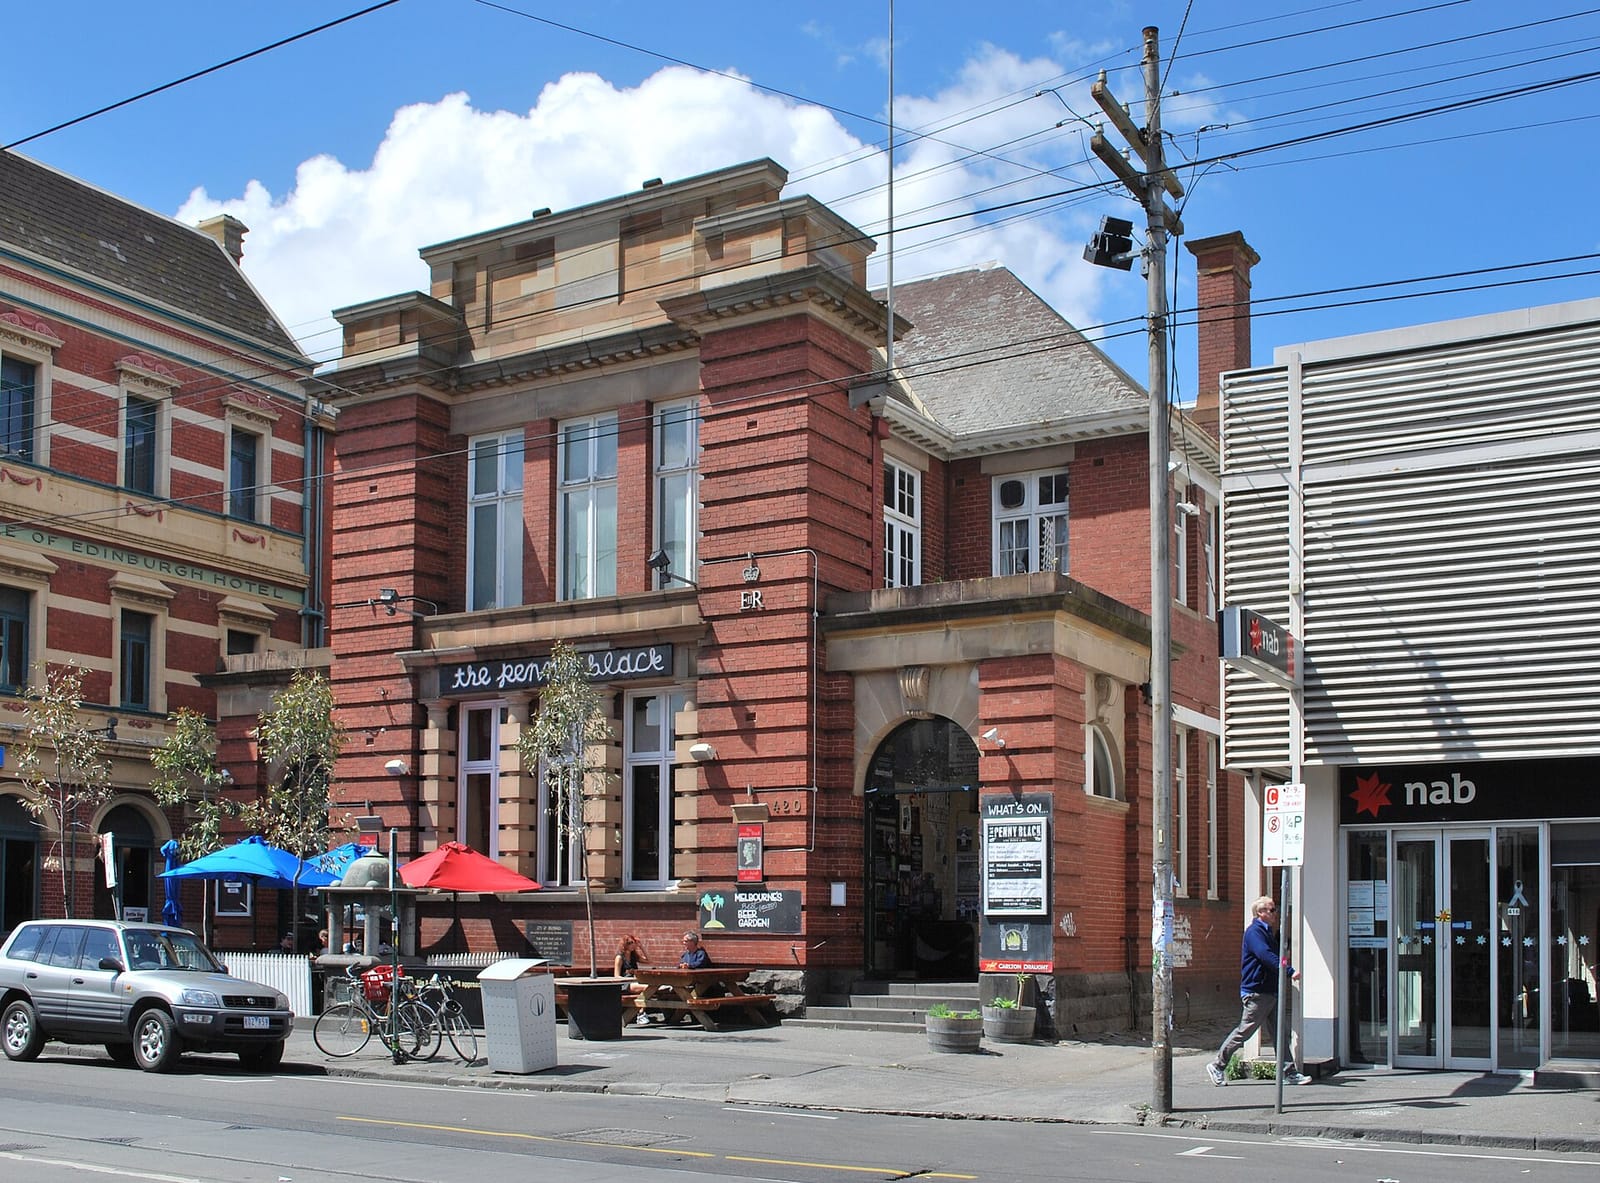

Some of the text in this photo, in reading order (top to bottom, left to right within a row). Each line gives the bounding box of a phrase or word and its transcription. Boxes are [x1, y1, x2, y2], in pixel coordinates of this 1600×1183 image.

[32, 532, 59, 546] OF
[72, 541, 203, 580] EDINBURGH
[214, 573, 284, 599] HOTEL
[1262, 629, 1280, 656] nab
[452, 665, 491, 688] the
[583, 648, 665, 677] black
[1404, 773, 1476, 805] nab
[773, 800, 802, 814] 420
[988, 802, 1024, 815] WHAT'S
[994, 826, 1017, 838] PENNY
[1018, 824, 1041, 837] BLACK
[734, 891, 783, 902] MELBOURNE'S
[737, 909, 758, 919] BEER
